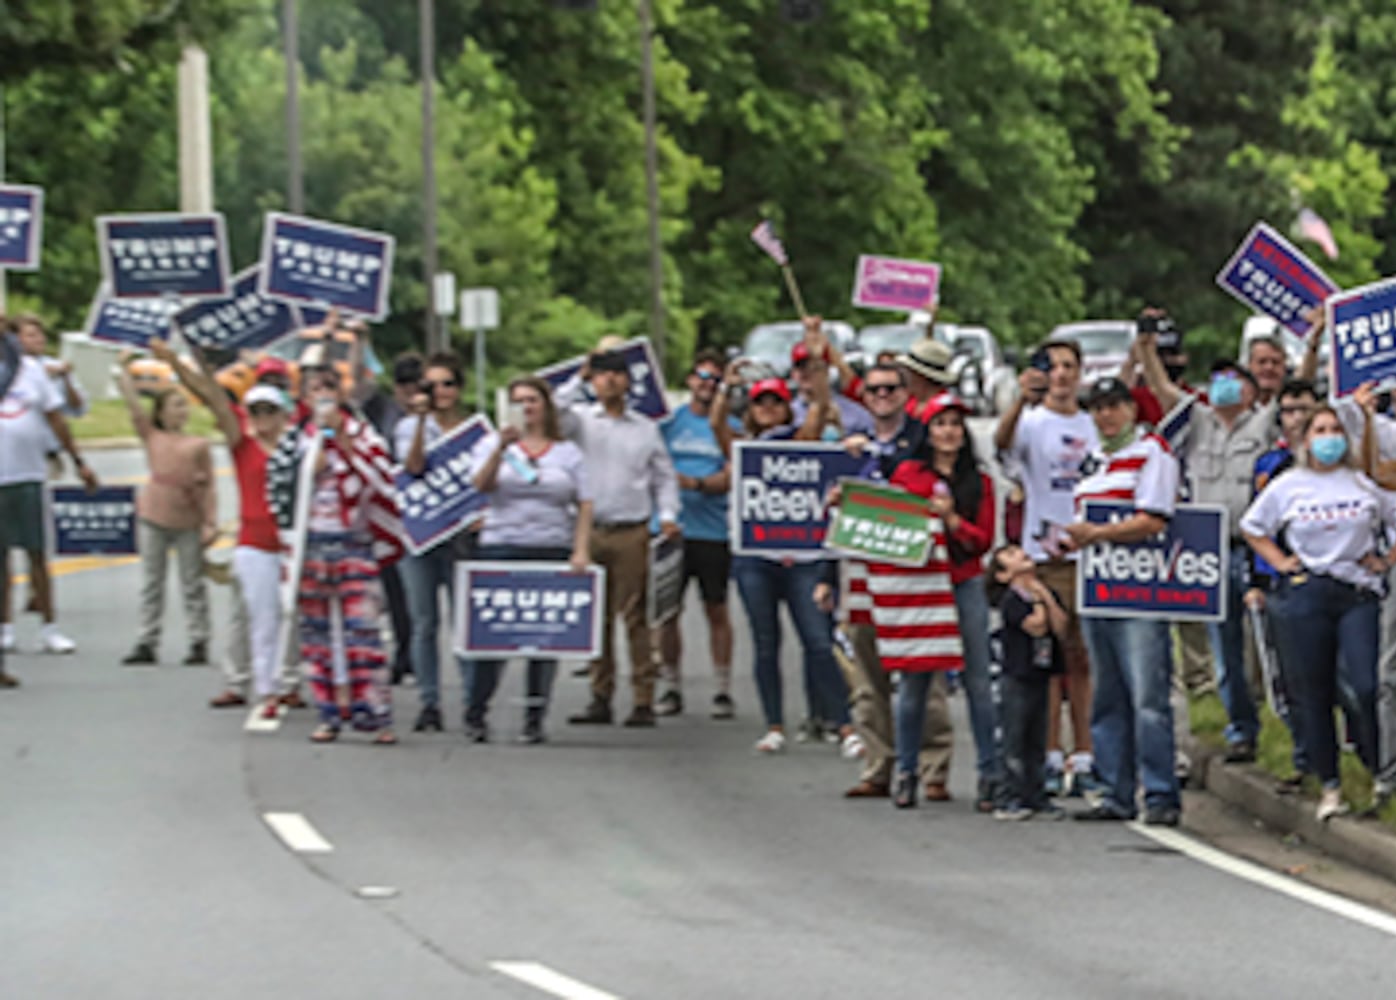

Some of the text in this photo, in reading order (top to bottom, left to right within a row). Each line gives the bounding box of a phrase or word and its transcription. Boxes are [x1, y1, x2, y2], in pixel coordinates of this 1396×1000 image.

[110, 236, 217, 256] TRUMP
[275, 238, 382, 272] TRUMP
[184, 293, 261, 339] TRUM
[397, 451, 474, 511] TRUM
[761, 455, 823, 482] Matt
[742, 476, 826, 521] Reev
[841, 516, 927, 544] TRUMP
[1085, 540, 1219, 586] Reeves
[473, 587, 592, 607] TRUMP
